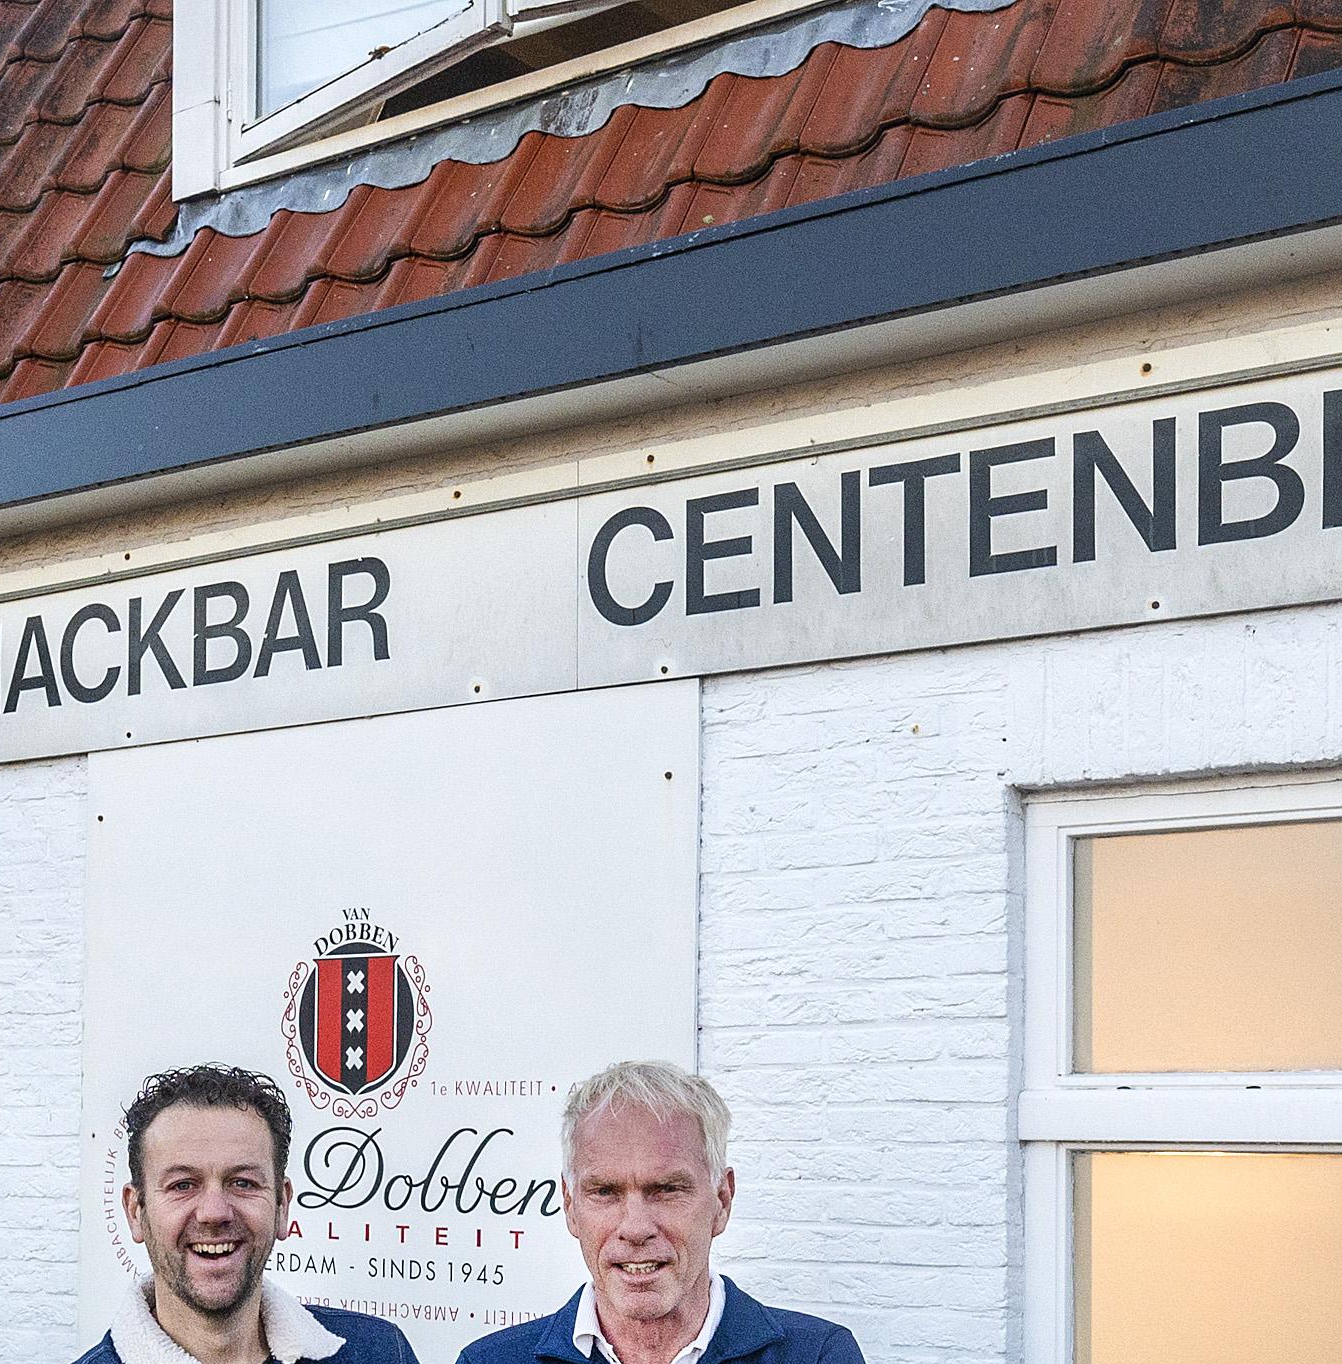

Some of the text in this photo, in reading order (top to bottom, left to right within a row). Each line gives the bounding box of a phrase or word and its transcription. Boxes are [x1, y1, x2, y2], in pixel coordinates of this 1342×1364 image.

[342, 907, 370, 921] VAN
[312, 922, 400, 957] DOBBEN
[430, 1080, 543, 1097] 1e KWALITEIT
[296, 1126, 561, 1217] Dobben
[287, 1220, 525, 1250] ALITEIT
[367, 1257, 436, 1282] SINDS
[447, 1261, 505, 1286] 1945
